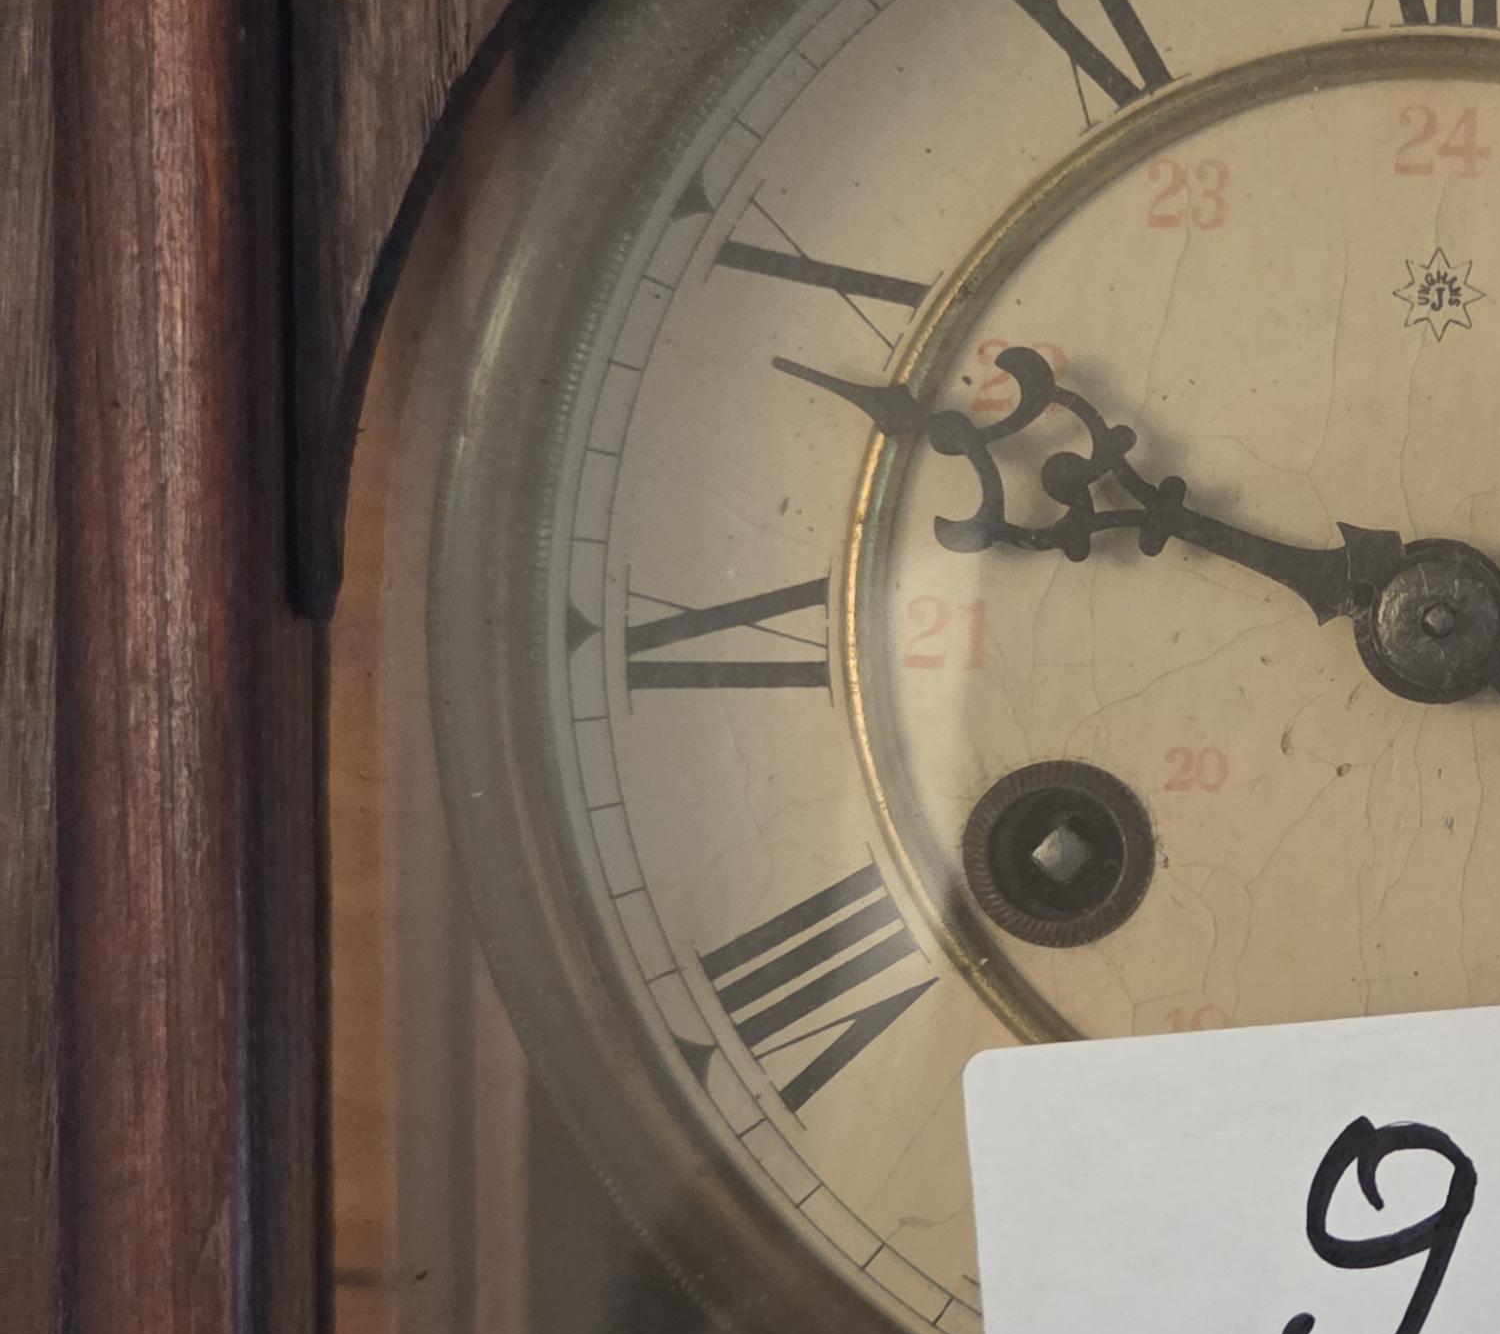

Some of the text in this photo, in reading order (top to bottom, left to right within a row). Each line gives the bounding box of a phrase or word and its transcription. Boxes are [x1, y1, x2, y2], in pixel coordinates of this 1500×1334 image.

[1395, 104, 1491, 179] 24
[1146, 159, 1230, 230] 23
[703, 178, 945, 372] X
[624, 564, 834, 716] IX
[904, 595, 986, 670] 21
[1163, 745, 1229, 794] 20
[690, 841, 939, 1130] VIII
